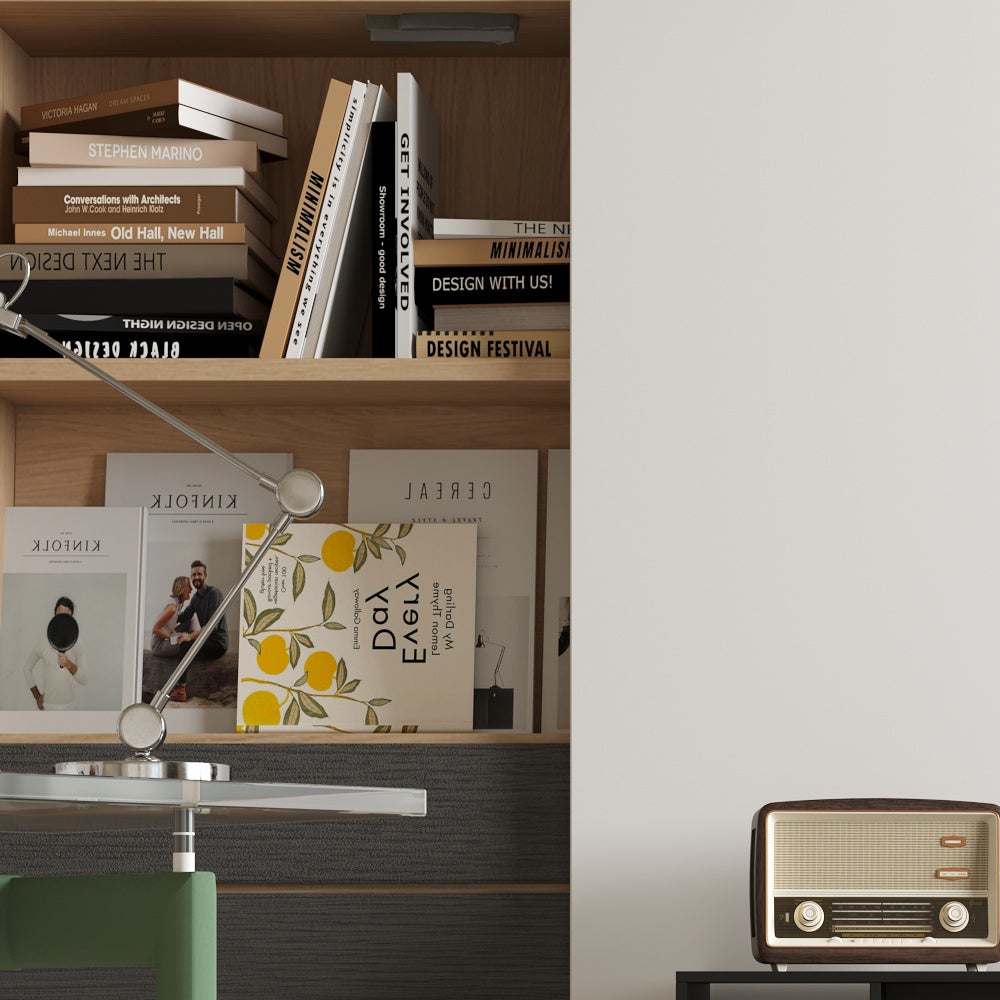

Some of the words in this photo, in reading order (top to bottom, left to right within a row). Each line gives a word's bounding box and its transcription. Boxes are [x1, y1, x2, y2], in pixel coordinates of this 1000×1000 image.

[41, 104, 73, 120] VICTORIA
[74, 101, 98, 116] HAGAN
[88, 143, 148, 159] STEPHEN
[151, 144, 203, 161] MARINO
[400, 132, 410, 178] GET
[331, 176, 340, 189] is
[63, 194, 121, 205] Conversations
[122, 194, 140, 205] with
[141, 194, 181, 205] Architects
[327, 192, 336, 208] in
[65, 205, 80, 214] John
[107, 205, 121, 214] and
[122, 205, 148, 214] Heinrich
[149, 205, 164, 214] Klotz
[378, 185, 387, 239] Showroom
[286, 171, 325, 276] MINIMALISM
[513, 222, 547, 235] THE
[48, 228, 81, 238] Michael
[83, 228, 106, 238] Innes
[110, 226, 133, 240] Old
[137, 226, 164, 241] Hall,
[167, 226, 195, 240] New
[199, 226, 224, 240] Hall
[305, 213, 329, 292] everything
[400, 186, 410, 312] INVOLVED
[377, 249, 387, 273] good
[377, 274, 387, 310] design
[432, 276, 484, 292] DESIGN
[489, 275, 525, 291] WITH
[530, 274, 553, 290] US!
[299, 296, 309, 316] we
[292, 320, 302, 346] see
[427, 340, 480, 358] DESIGN
[487, 340, 552, 358] FESTIVAL
